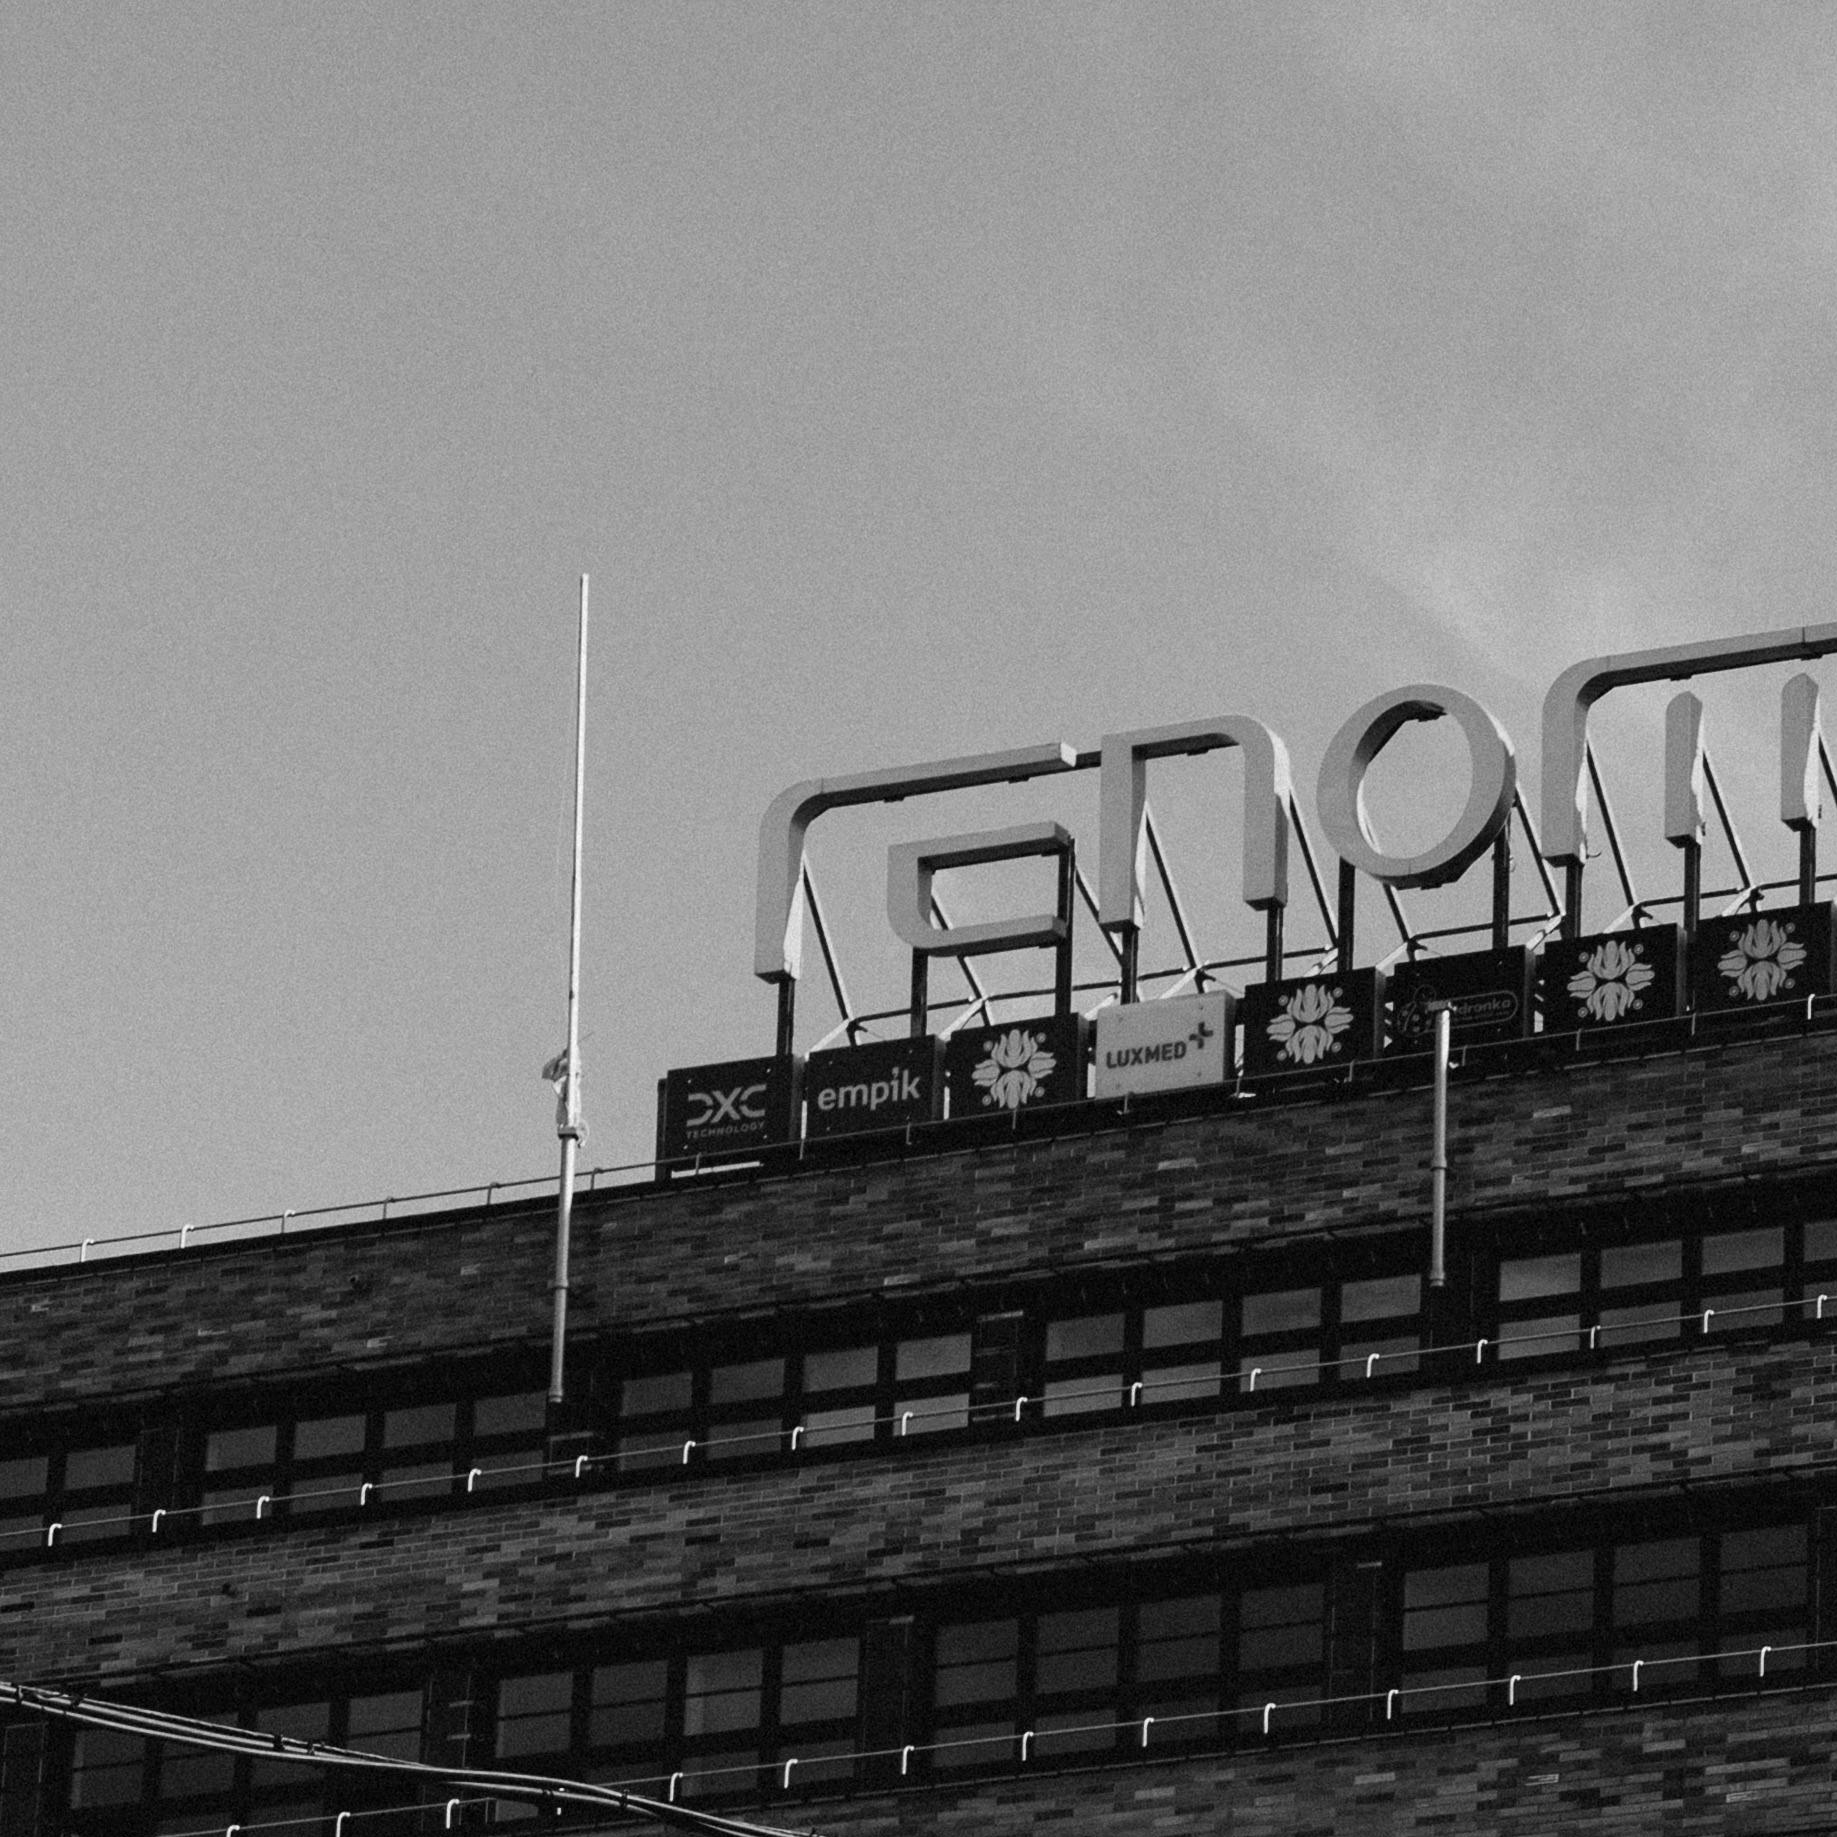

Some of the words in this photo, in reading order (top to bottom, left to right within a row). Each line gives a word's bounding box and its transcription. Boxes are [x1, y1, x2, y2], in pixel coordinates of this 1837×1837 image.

[1106, 1041, 1187, 1069] LUXMED
[686, 1083, 767, 1127] DXC
[817, 1066, 921, 1111] empik
[686, 1120, 766, 1139] TECHNOLOGY
